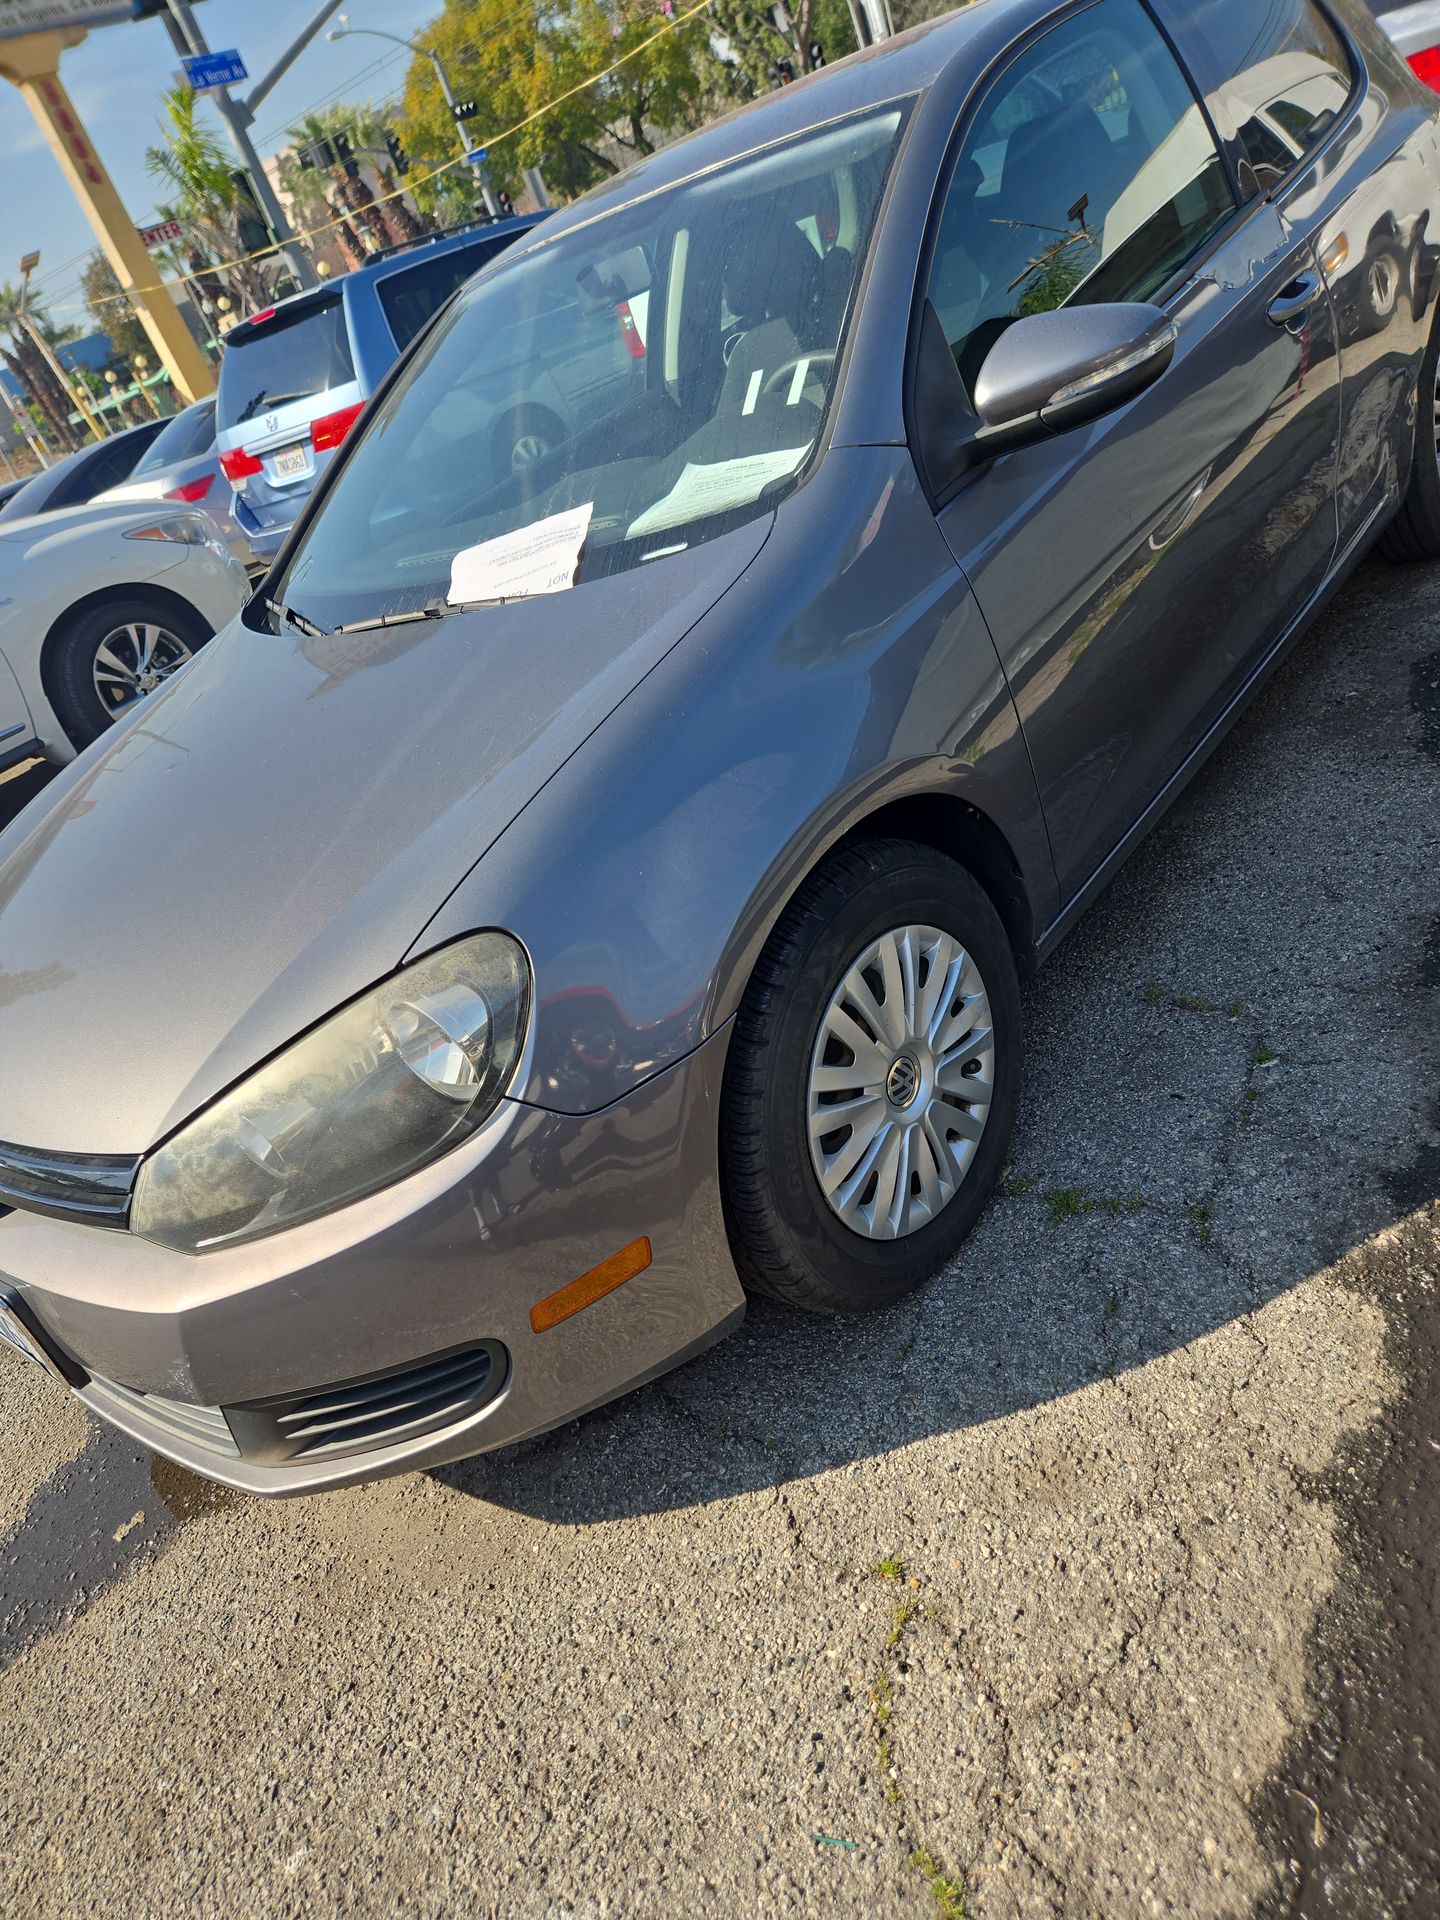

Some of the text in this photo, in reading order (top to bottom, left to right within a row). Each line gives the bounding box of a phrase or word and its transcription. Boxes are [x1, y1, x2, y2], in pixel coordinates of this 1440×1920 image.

[190, 73, 206, 88] La
[203, 68, 233, 84] Verne
[546, 571, 570, 589] NOT
